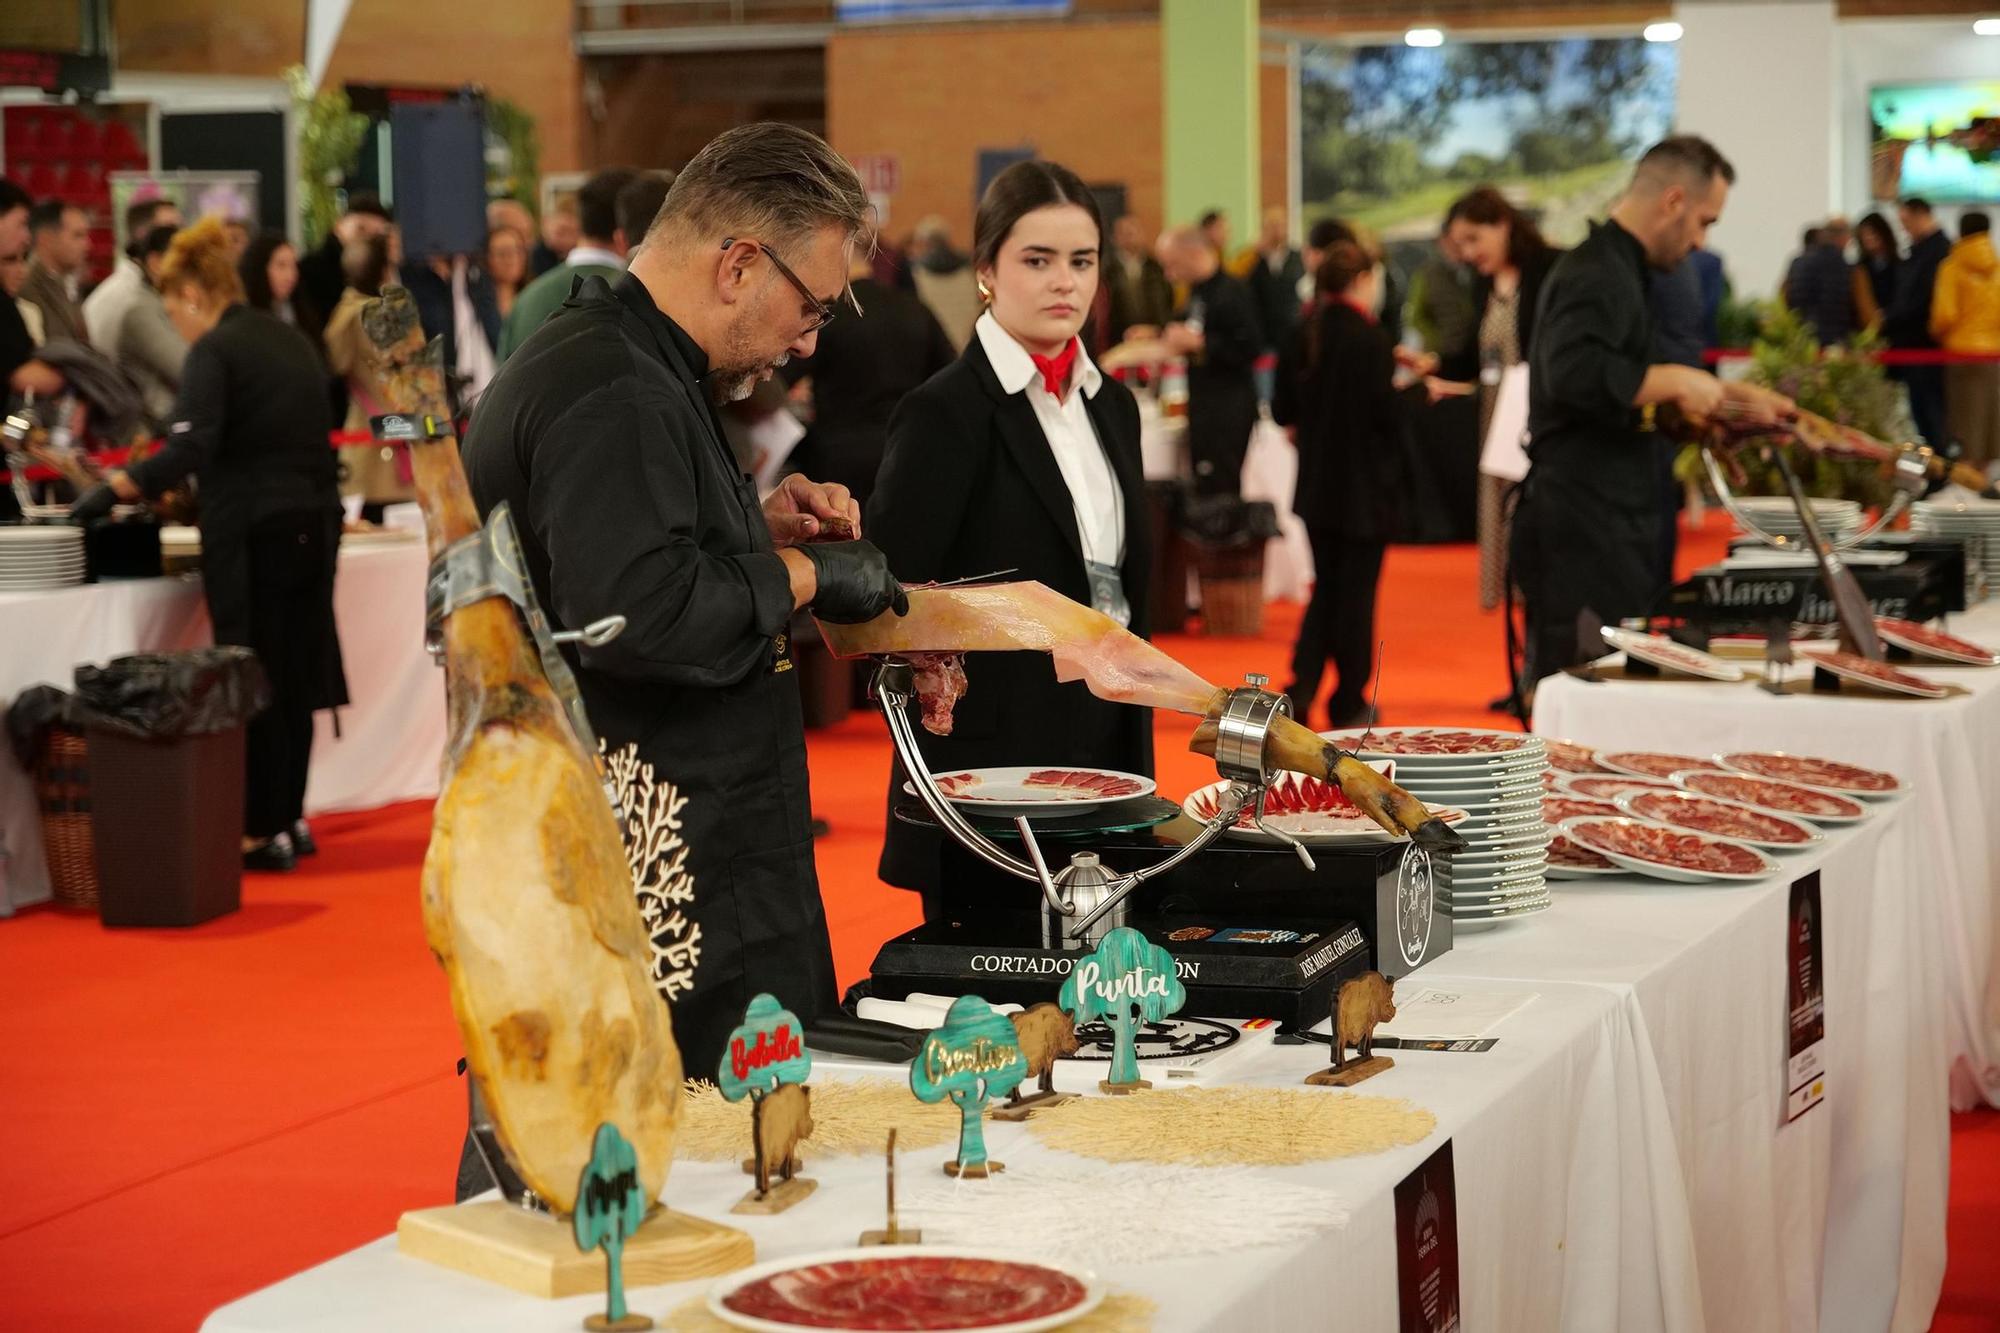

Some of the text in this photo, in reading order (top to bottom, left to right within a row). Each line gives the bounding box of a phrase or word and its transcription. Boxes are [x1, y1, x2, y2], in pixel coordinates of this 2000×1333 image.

[1704, 576, 1794, 606] Marco
[970, 955, 1077, 975] CORTADO
[1299, 954, 1317, 978] JOSÉ
[1311, 944, 1338, 970] MANUEL
[1333, 927, 1363, 956] GONZÁLEZ
[1076, 962, 1170, 1005] Punta
[925, 1037, 1017, 1087] Creativo
